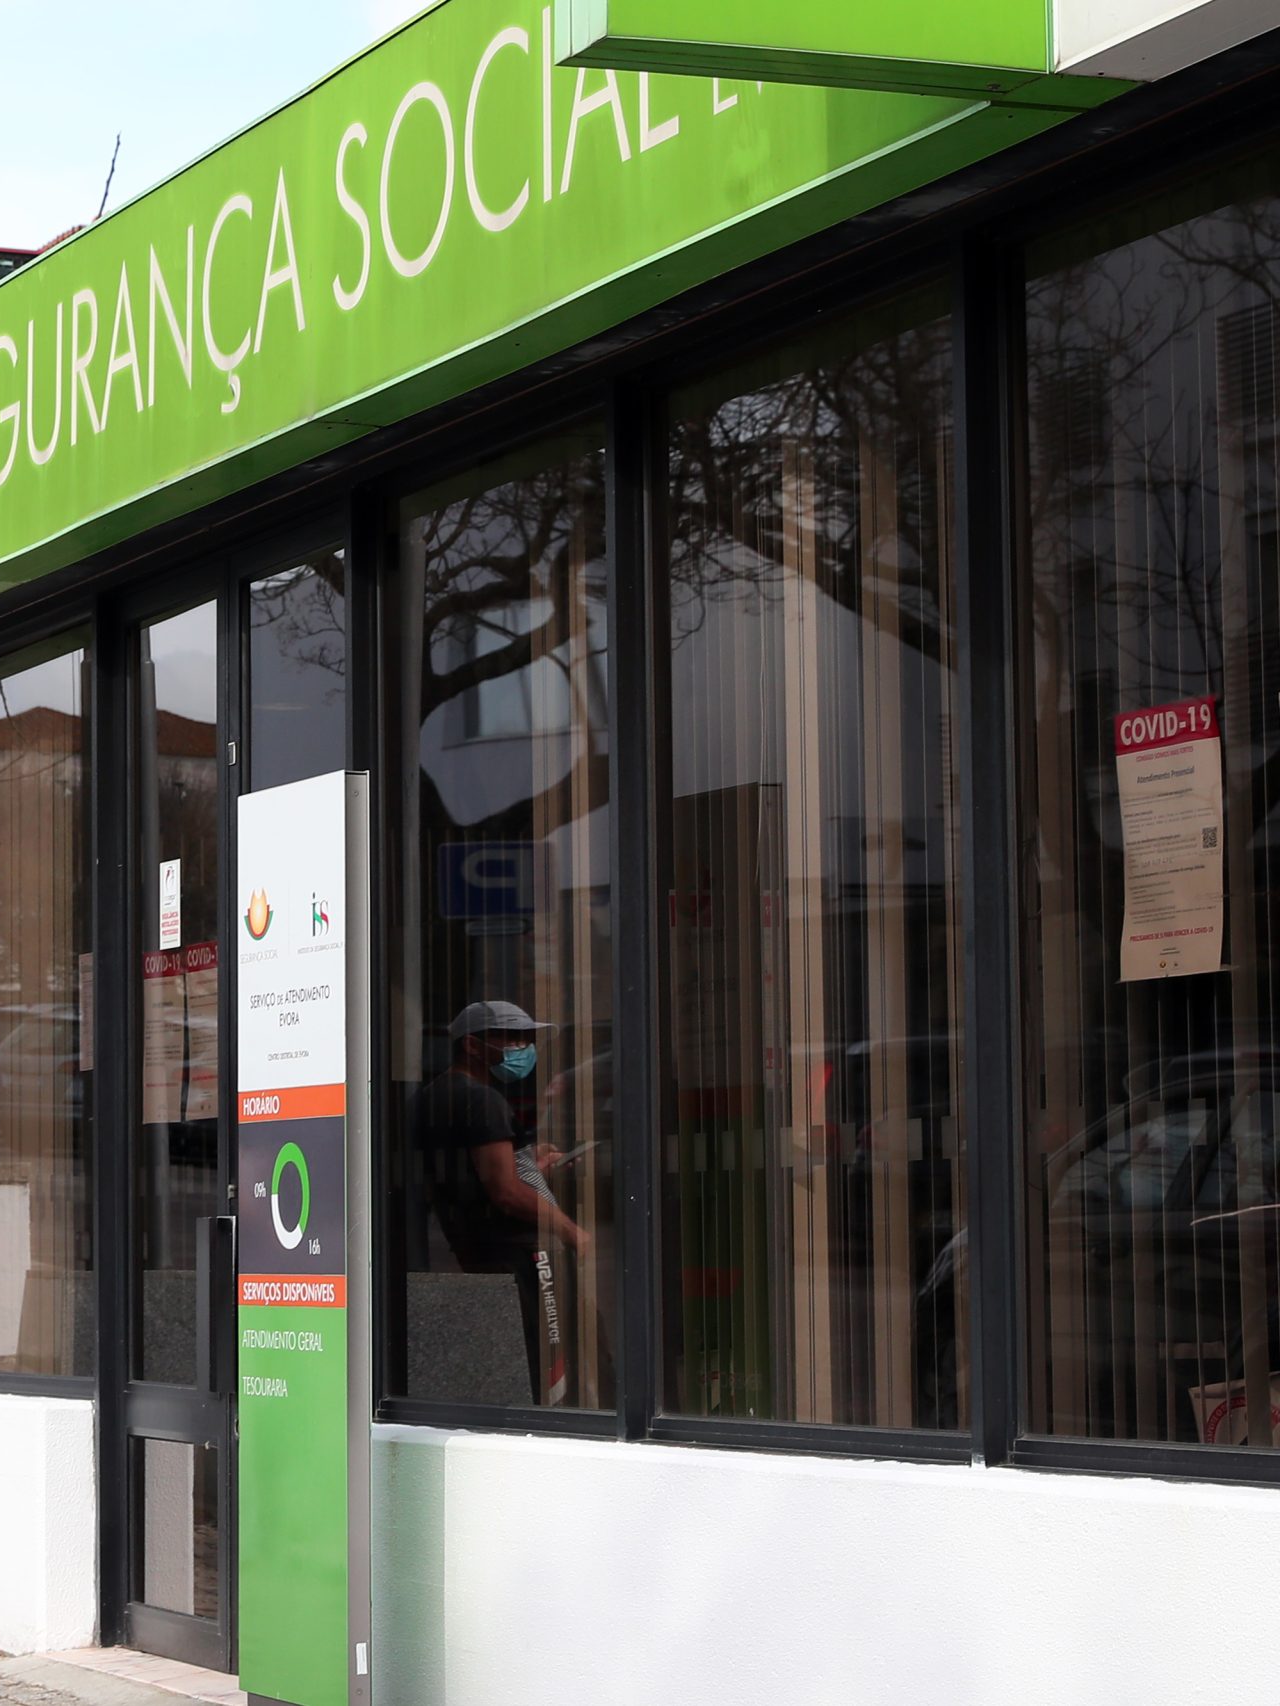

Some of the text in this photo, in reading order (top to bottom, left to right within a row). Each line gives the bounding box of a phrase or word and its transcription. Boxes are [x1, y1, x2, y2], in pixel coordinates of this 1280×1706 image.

[333, 5, 680, 311] SOCIAL
[1120, 703, 1211, 745] COVID-19
[145, 953, 180, 973] COVID-19
[250, 992, 276, 1010] SERVIÇO
[285, 985, 330, 1004] ATENDIMENTO
[243, 1092, 279, 1116] HORÁRIO
[254, 1182, 266, 1198] 09h
[308, 1238, 320, 1255] 16h
[243, 1282, 281, 1305] SERVIÇOS
[242, 1329, 323, 1352] ATENDIMENTO GERAL
[242, 1376, 288, 1398] TESOURARIA
